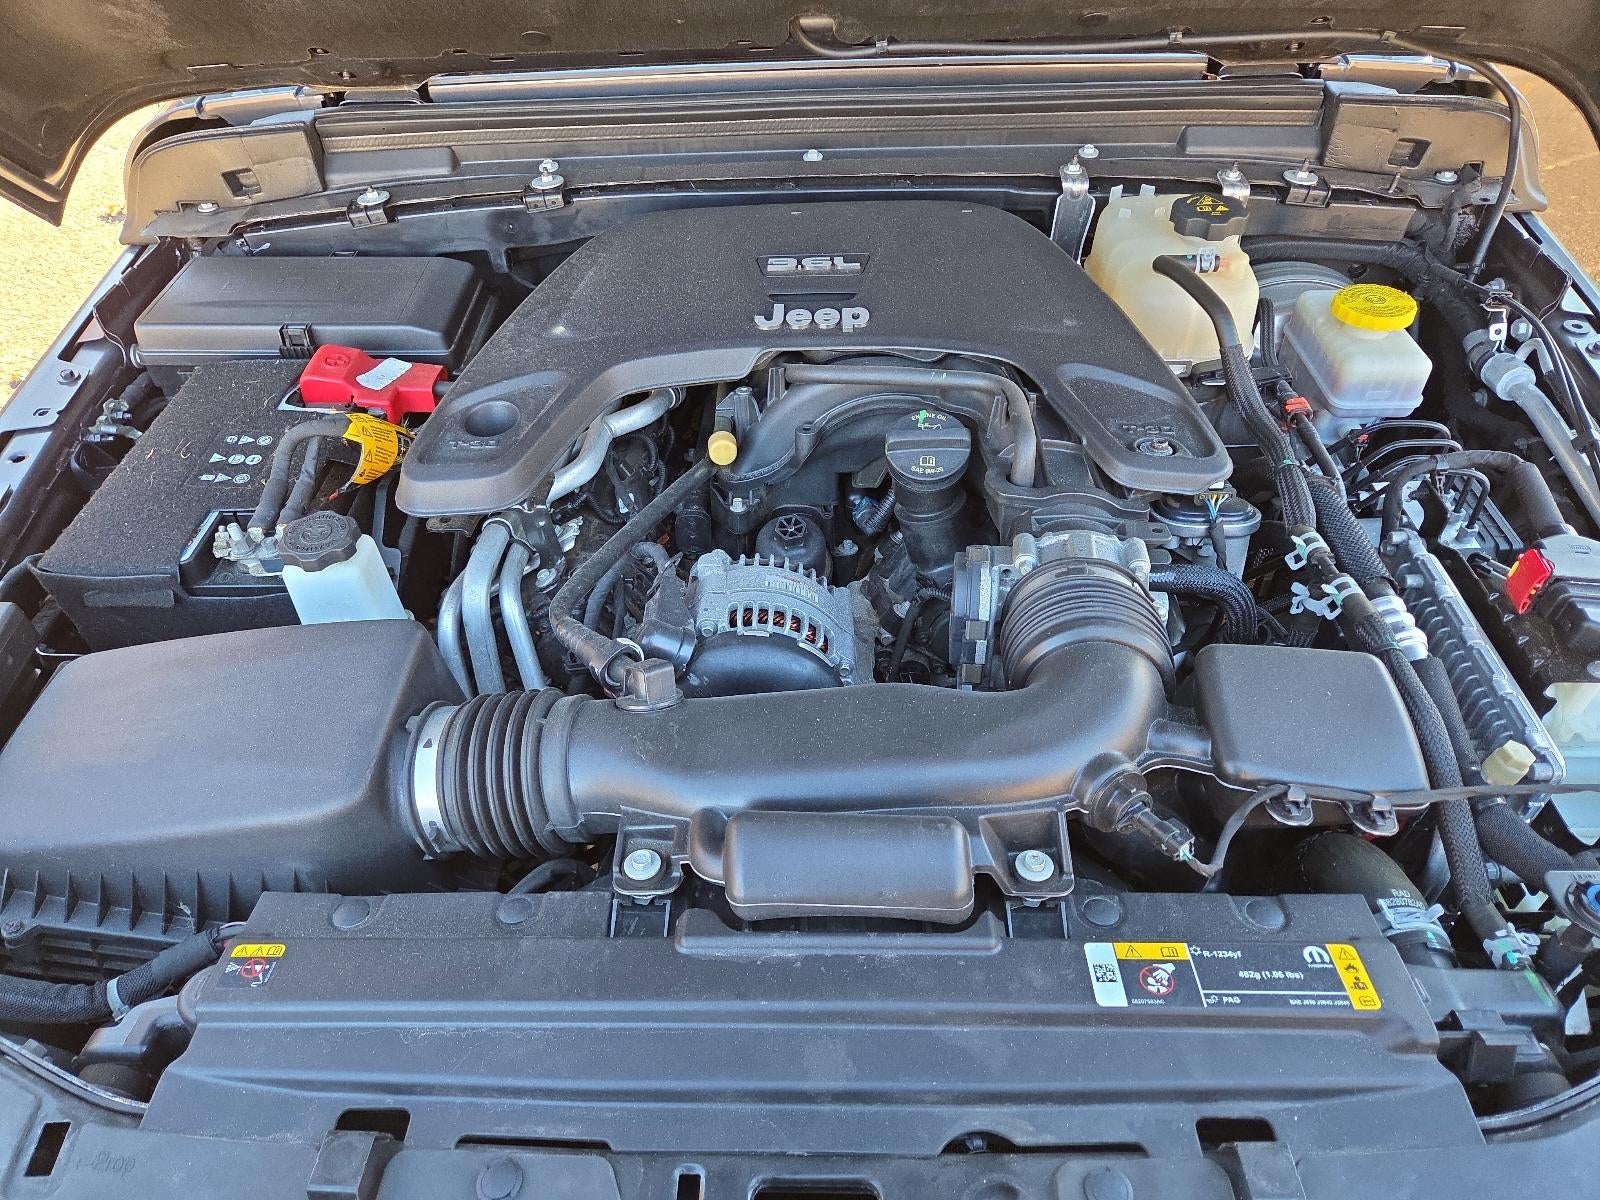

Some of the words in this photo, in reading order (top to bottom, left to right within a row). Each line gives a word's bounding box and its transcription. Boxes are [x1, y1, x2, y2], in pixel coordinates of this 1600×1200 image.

[754, 303, 870, 332] Jeep
[1391, 888, 1411, 898] RAD
[1202, 950, 1242, 960] R-1234yf
[1222, 996, 1241, 1004] PAG
